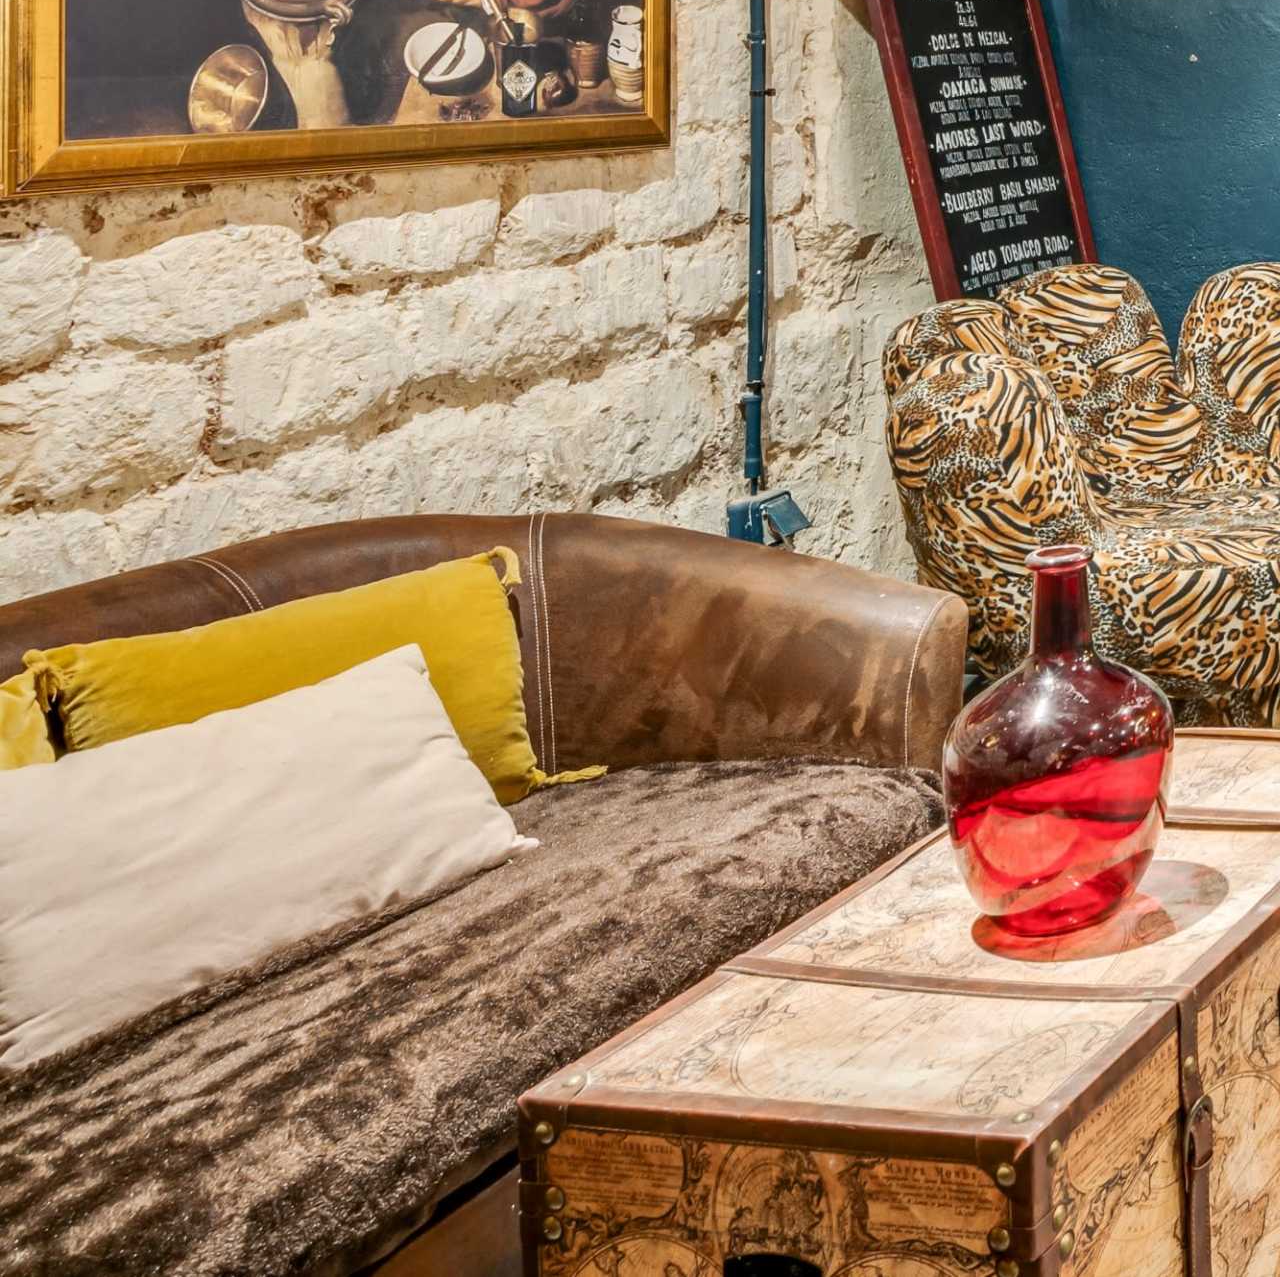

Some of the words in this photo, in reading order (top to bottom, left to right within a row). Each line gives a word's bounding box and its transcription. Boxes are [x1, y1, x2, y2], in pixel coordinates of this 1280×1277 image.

[963, 31, 975, 48] DE
[977, 30, 1009, 47] MEZCAL
[941, 78, 987, 99] OAXACA
[935, 127, 980, 153] AMORES
[982, 122, 1006, 144] LAST
[1009, 120, 1042, 138] WORD
[944, 186, 994, 214] BLUEBERRY
[999, 181, 1025, 201] BASIL
[1024, 175, 1057, 195] SMASH
[970, 249, 998, 275] AGED
[1000, 239, 1042, 265] TOBACCO
[1043, 235, 1070, 255] ROAD
